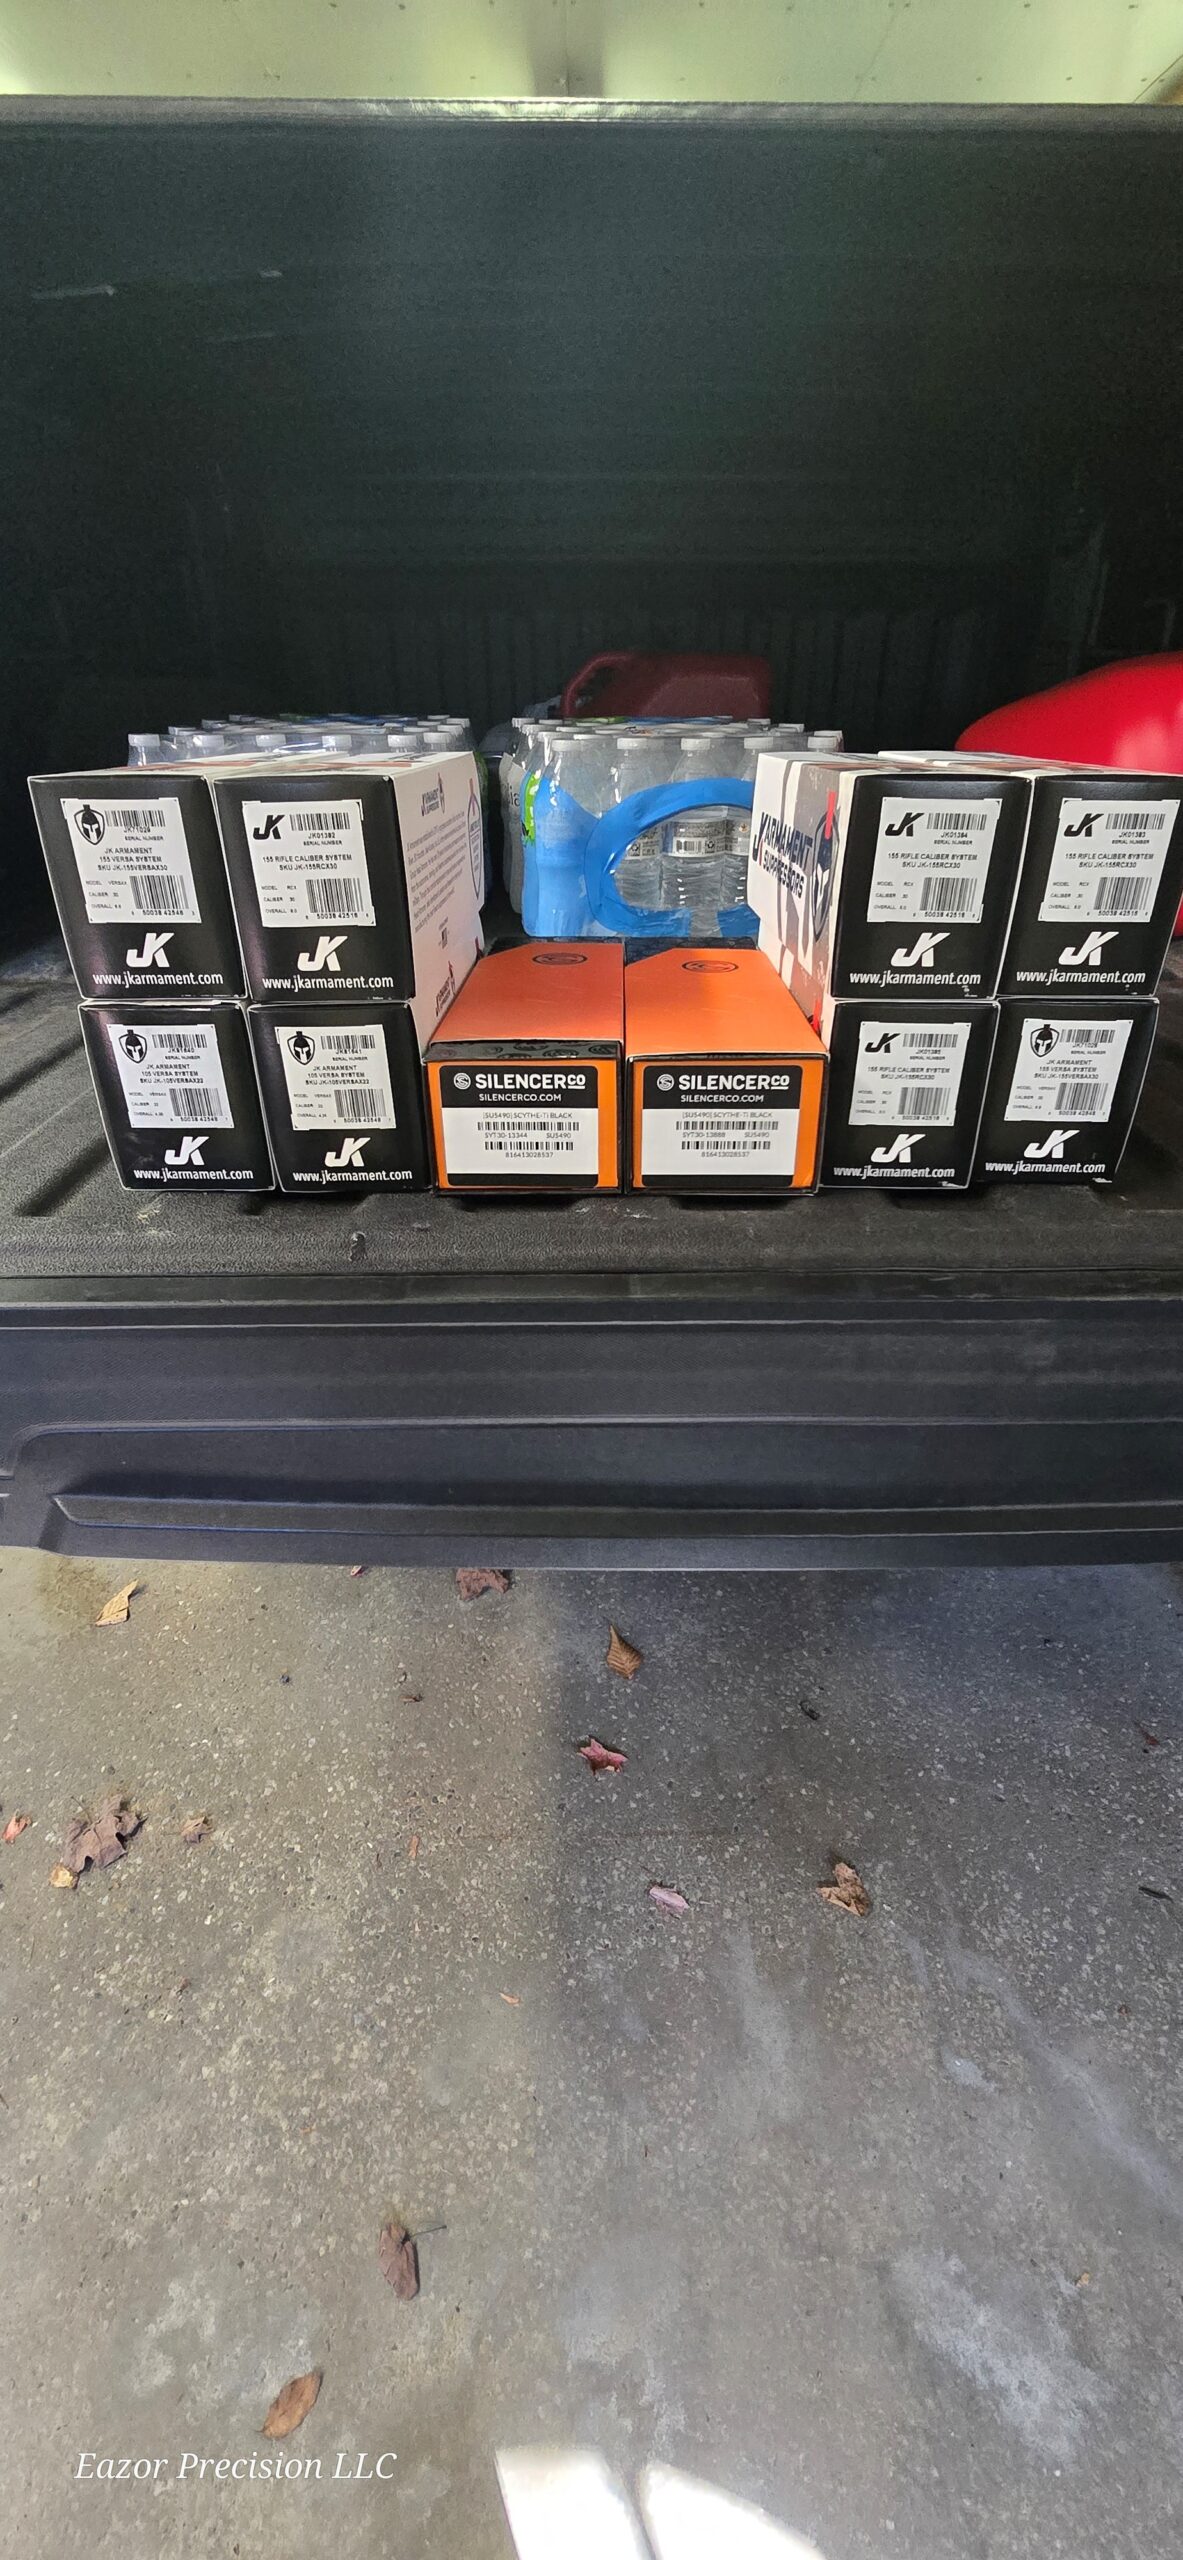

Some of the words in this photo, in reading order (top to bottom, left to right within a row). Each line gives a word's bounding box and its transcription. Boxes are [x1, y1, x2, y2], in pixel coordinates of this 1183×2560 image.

[253, 815, 285, 840] JK
[885, 812, 925, 837] JK
[1064, 813, 1104, 837] JK
[764, 813, 814, 871] ARMAMENT
[763, 849, 804, 898] SUPPRESSORS
[126, 932, 175, 968] JK
[297, 935, 348, 972] JK
[890, 932, 950, 967] JK
[1058, 931, 1119, 966] JK
[93, 971, 223, 989] www.jkarmament.com
[262, 975, 394, 992] www.jkarmament.com
[850, 970, 981, 988] www.jkarmament.com
[1017, 969, 1146, 985] www.jkarmament.com
[865, 1033, 901, 1053] JK
[476, 1073, 586, 1090] SILENCERCO
[678, 1074, 790, 1090] SILENCERCO
[681, 1095, 764, 1103] SILENCERCO.COM
[164, 1136, 209, 1166] JK
[324, 1137, 370, 1167] JK
[870, 1133, 926, 1163] JK
[1023, 1130, 1080, 1159] JK
[134, 1168, 253, 1182] www.jkarmament.com
[293, 1170, 412, 1184] www.jkarmament.com
[833, 1165, 955, 1179] www.jkarmament.com
[985, 1160, 1105, 1174] www.jkarmament.com
